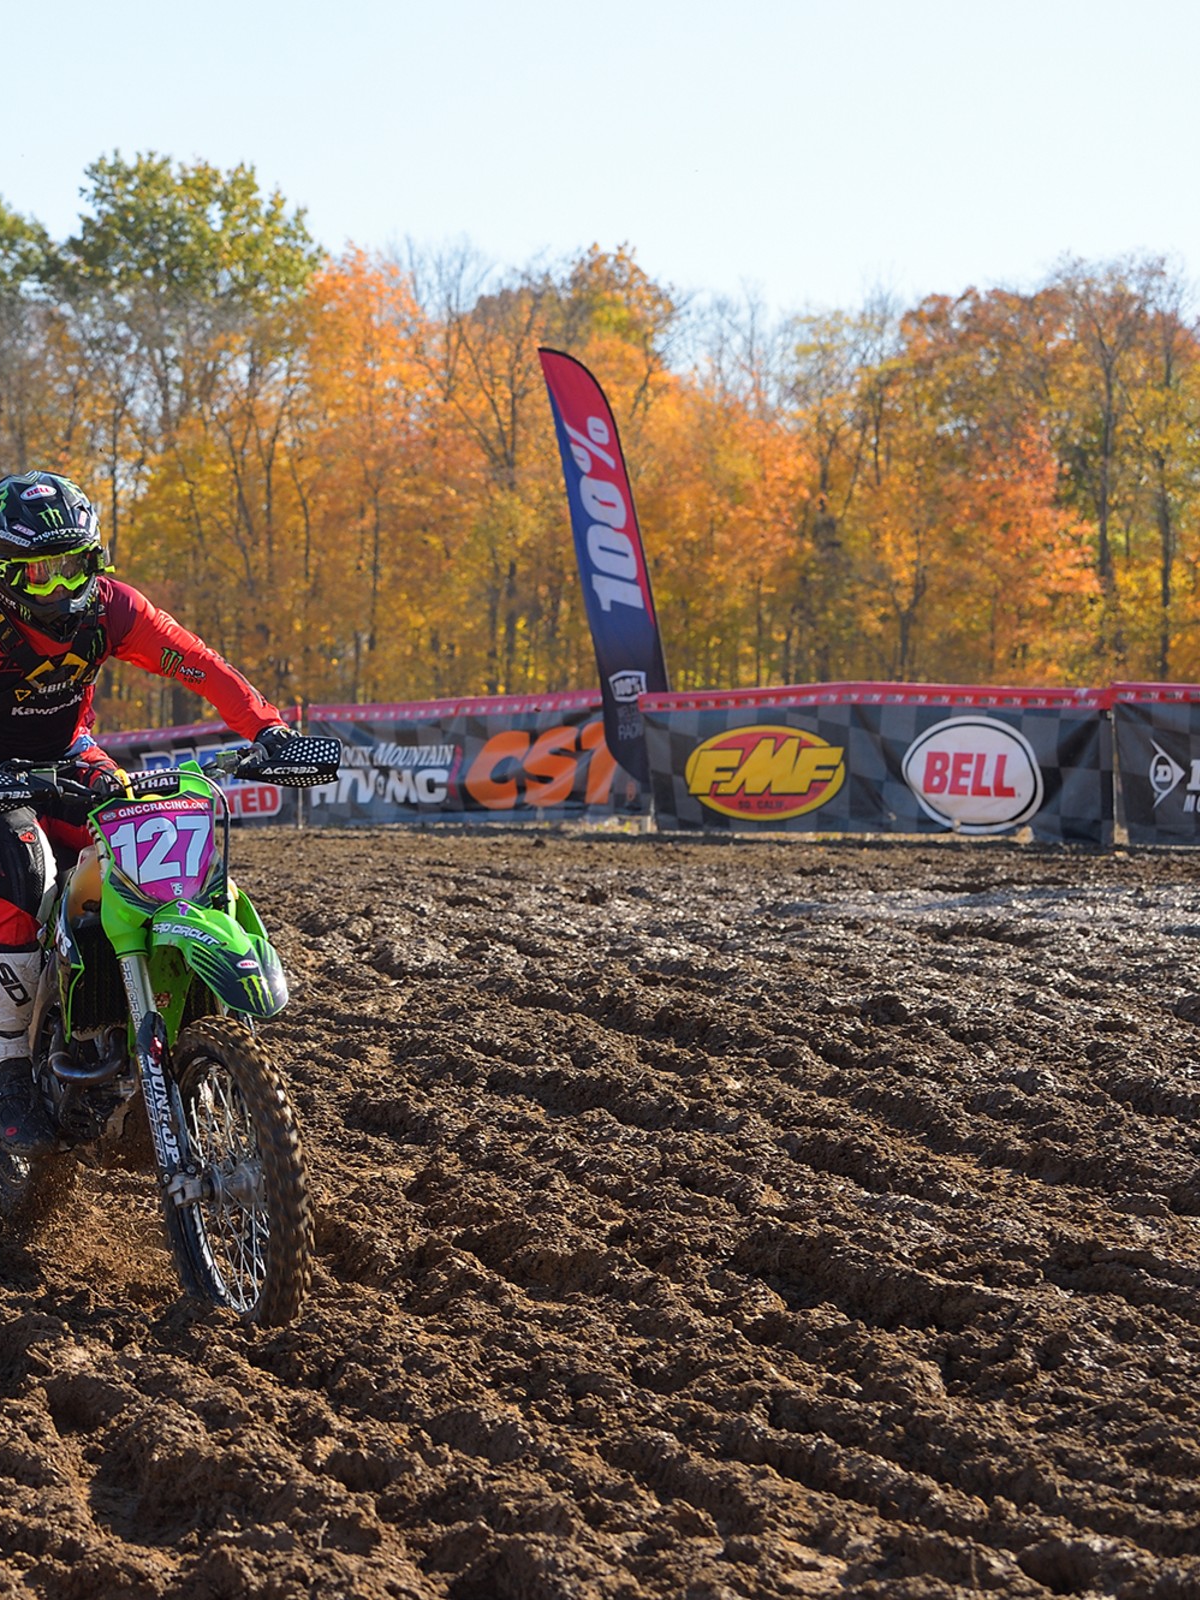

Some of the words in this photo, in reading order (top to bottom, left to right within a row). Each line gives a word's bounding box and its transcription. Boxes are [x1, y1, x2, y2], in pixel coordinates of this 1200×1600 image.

[26, 487, 50, 498] BELL
[564, 416, 644, 612] 100%
[374, 742, 455, 766] MOUNTAIN
[465, 722, 617, 810] CST
[689, 737, 844, 795] FMF
[922, 751, 1016, 798] BELL
[110, 815, 211, 885] 127
[171, 924, 220, 945] CIRCUIT
